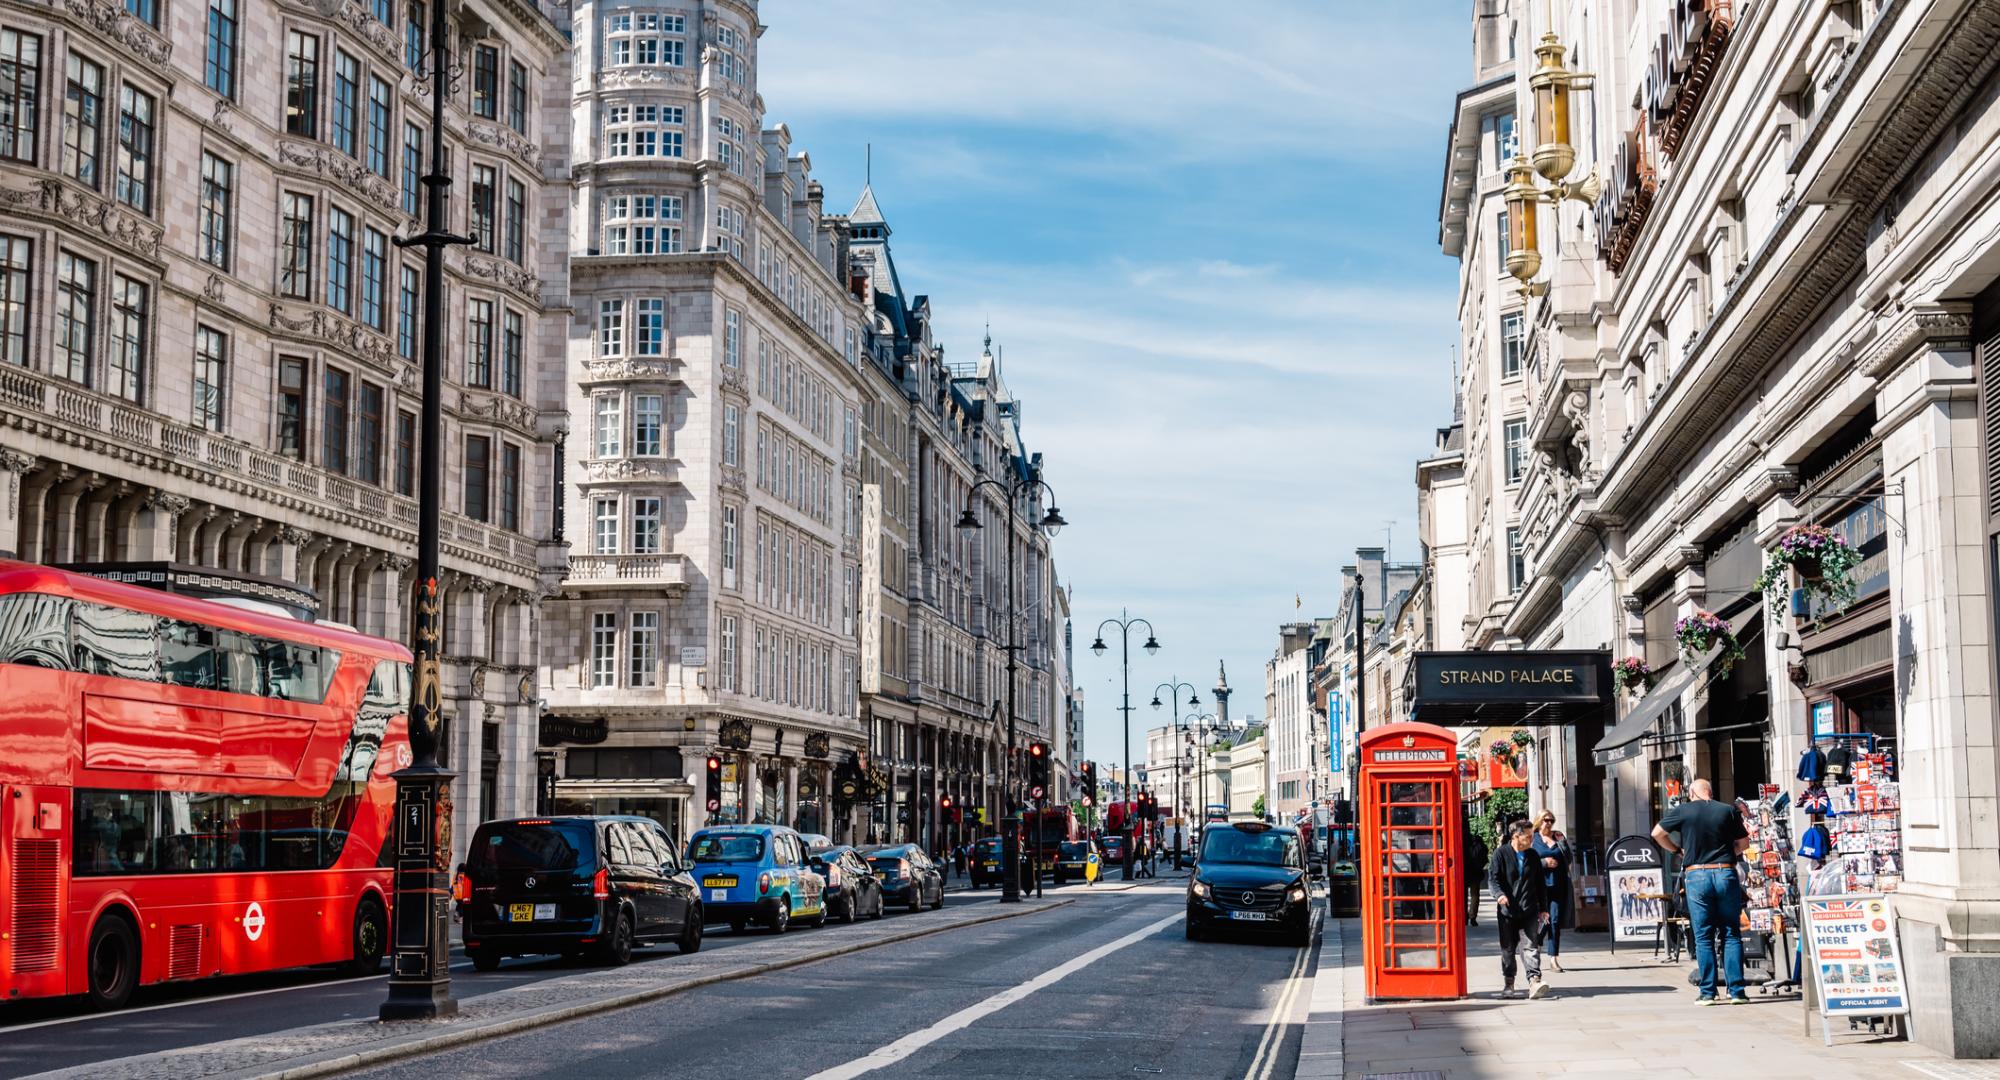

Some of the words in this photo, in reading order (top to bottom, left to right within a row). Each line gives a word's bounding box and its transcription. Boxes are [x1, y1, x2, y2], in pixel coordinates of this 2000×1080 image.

[866, 487, 875, 568] SAVOY
[865, 576, 874, 689] THEATRE
[1440, 670, 1505, 684] STRAND
[1511, 669, 1574, 683] PALACE
[1377, 751, 1443, 760] TELEPHONE
[514, 912, 529, 920] GKE
[1815, 924, 1868, 934] TICKETS
[1817, 936, 1849, 945] HERE
